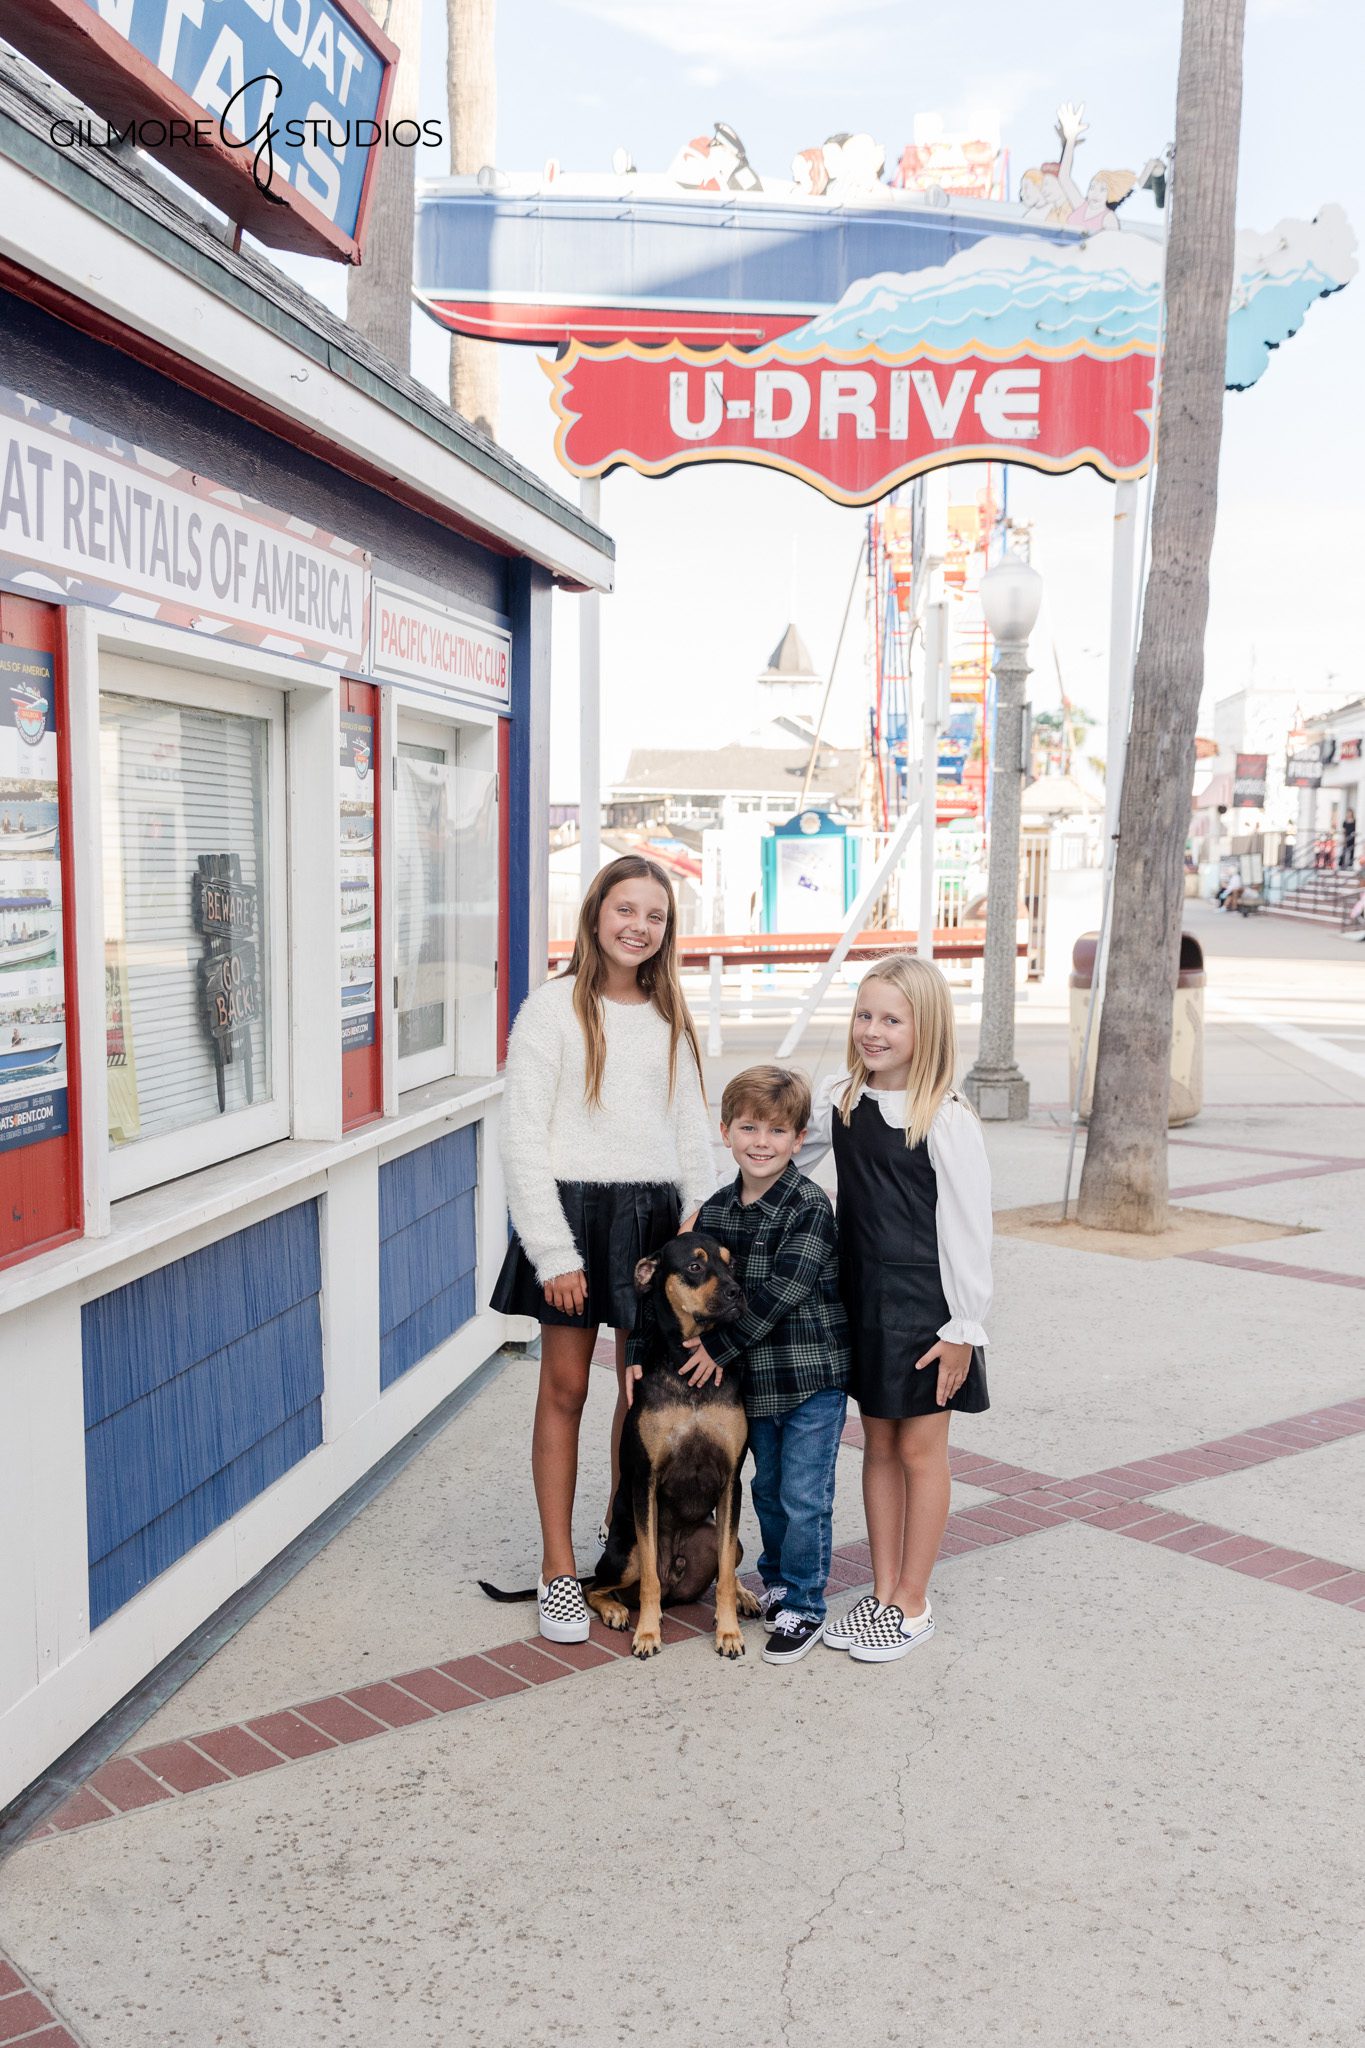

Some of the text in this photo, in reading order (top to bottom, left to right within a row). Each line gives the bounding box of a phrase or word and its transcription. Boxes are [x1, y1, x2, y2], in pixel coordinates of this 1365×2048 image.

[247, 0, 364, 107] OAT
[669, 368, 1041, 441] U-DRIVE
[0, 438, 353, 640] AT RENTALS OF AMERICA
[12, 662, 21, 673] OF
[22, 664, 50, 678] AMERICA
[380, 608, 507, 688] PACIFIC YACHTING CLUB
[207, 891, 251, 927] BEWARE
[222, 955, 242, 991] GO
[215, 984, 255, 1026] BACK!
